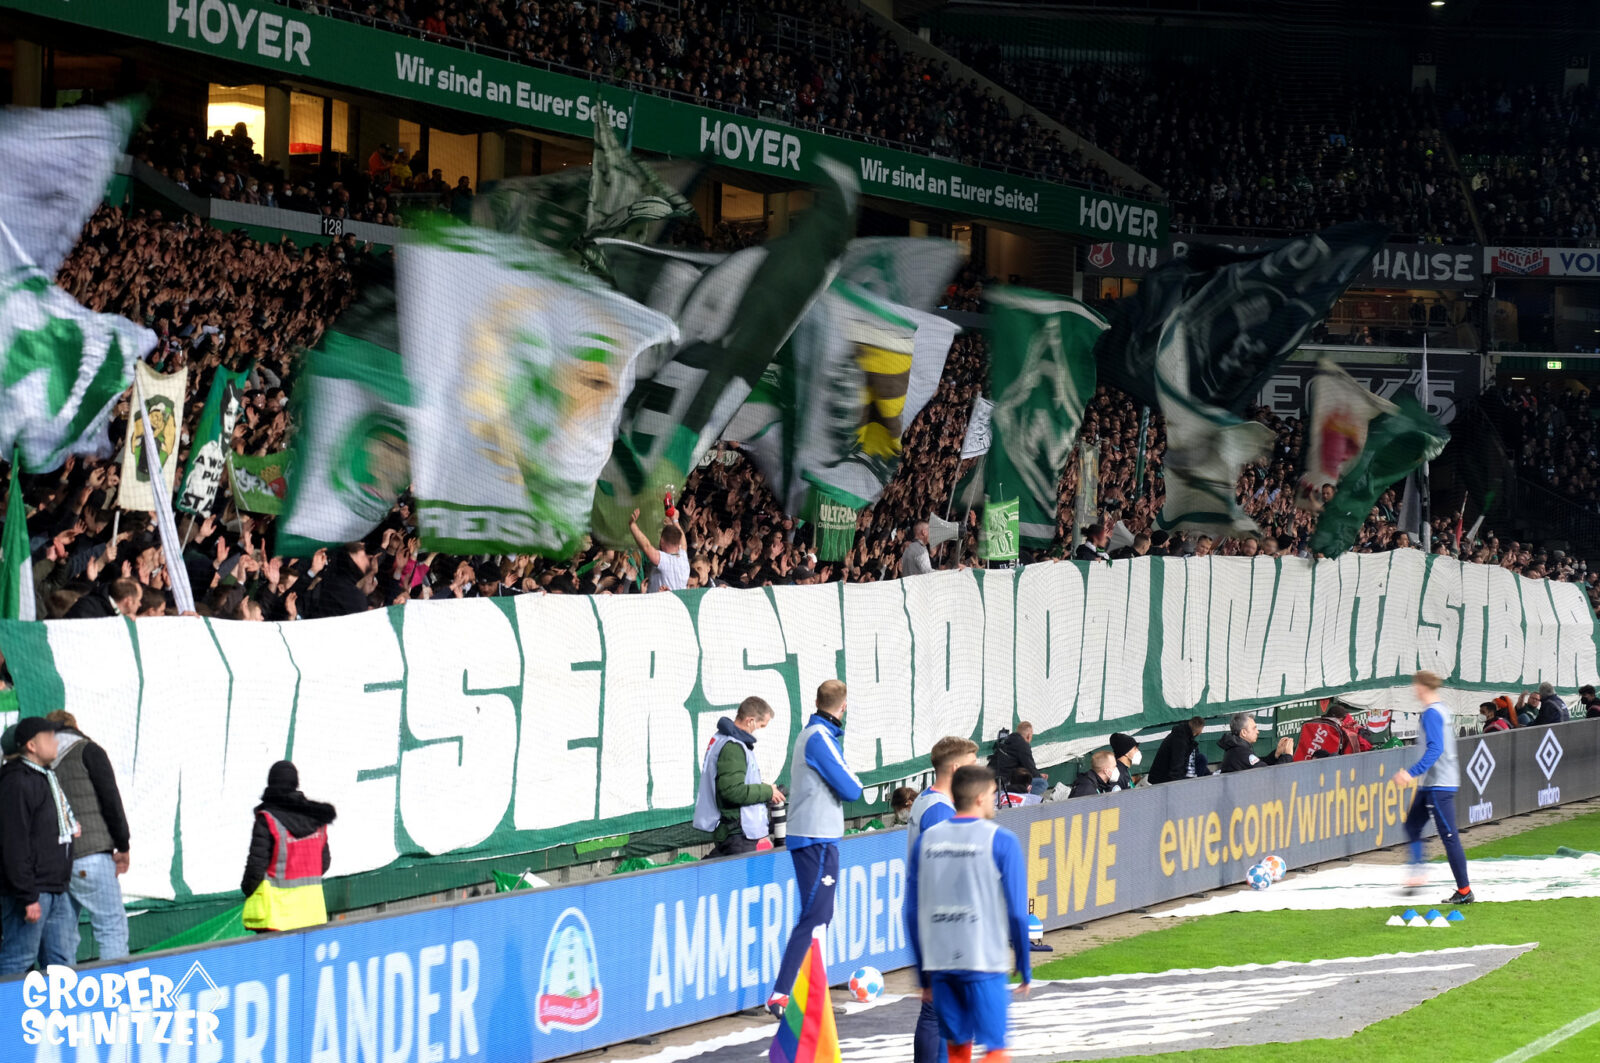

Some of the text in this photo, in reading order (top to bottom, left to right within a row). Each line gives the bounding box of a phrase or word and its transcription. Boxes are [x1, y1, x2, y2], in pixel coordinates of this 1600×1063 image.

[168, 0, 311, 66] HOYER
[395, 51, 434, 86] Wir
[437, 65, 483, 98] sind
[486, 83, 512, 104] an
[516, 80, 574, 118] Eurer
[701, 116, 801, 171] HOYER
[860, 156, 1040, 213] Wir sind an Eurer Seite!
[322, 217, 343, 236] 128
[1079, 195, 1159, 240] HOYER
[1371, 248, 1475, 282] HAUSE
[47, 547, 1600, 897] WESERSTADION UNANTASTBAR
[1469, 798, 1493, 824] umbro
[1538, 783, 1560, 807] umbro
[1027, 807, 1120, 920] EWE
